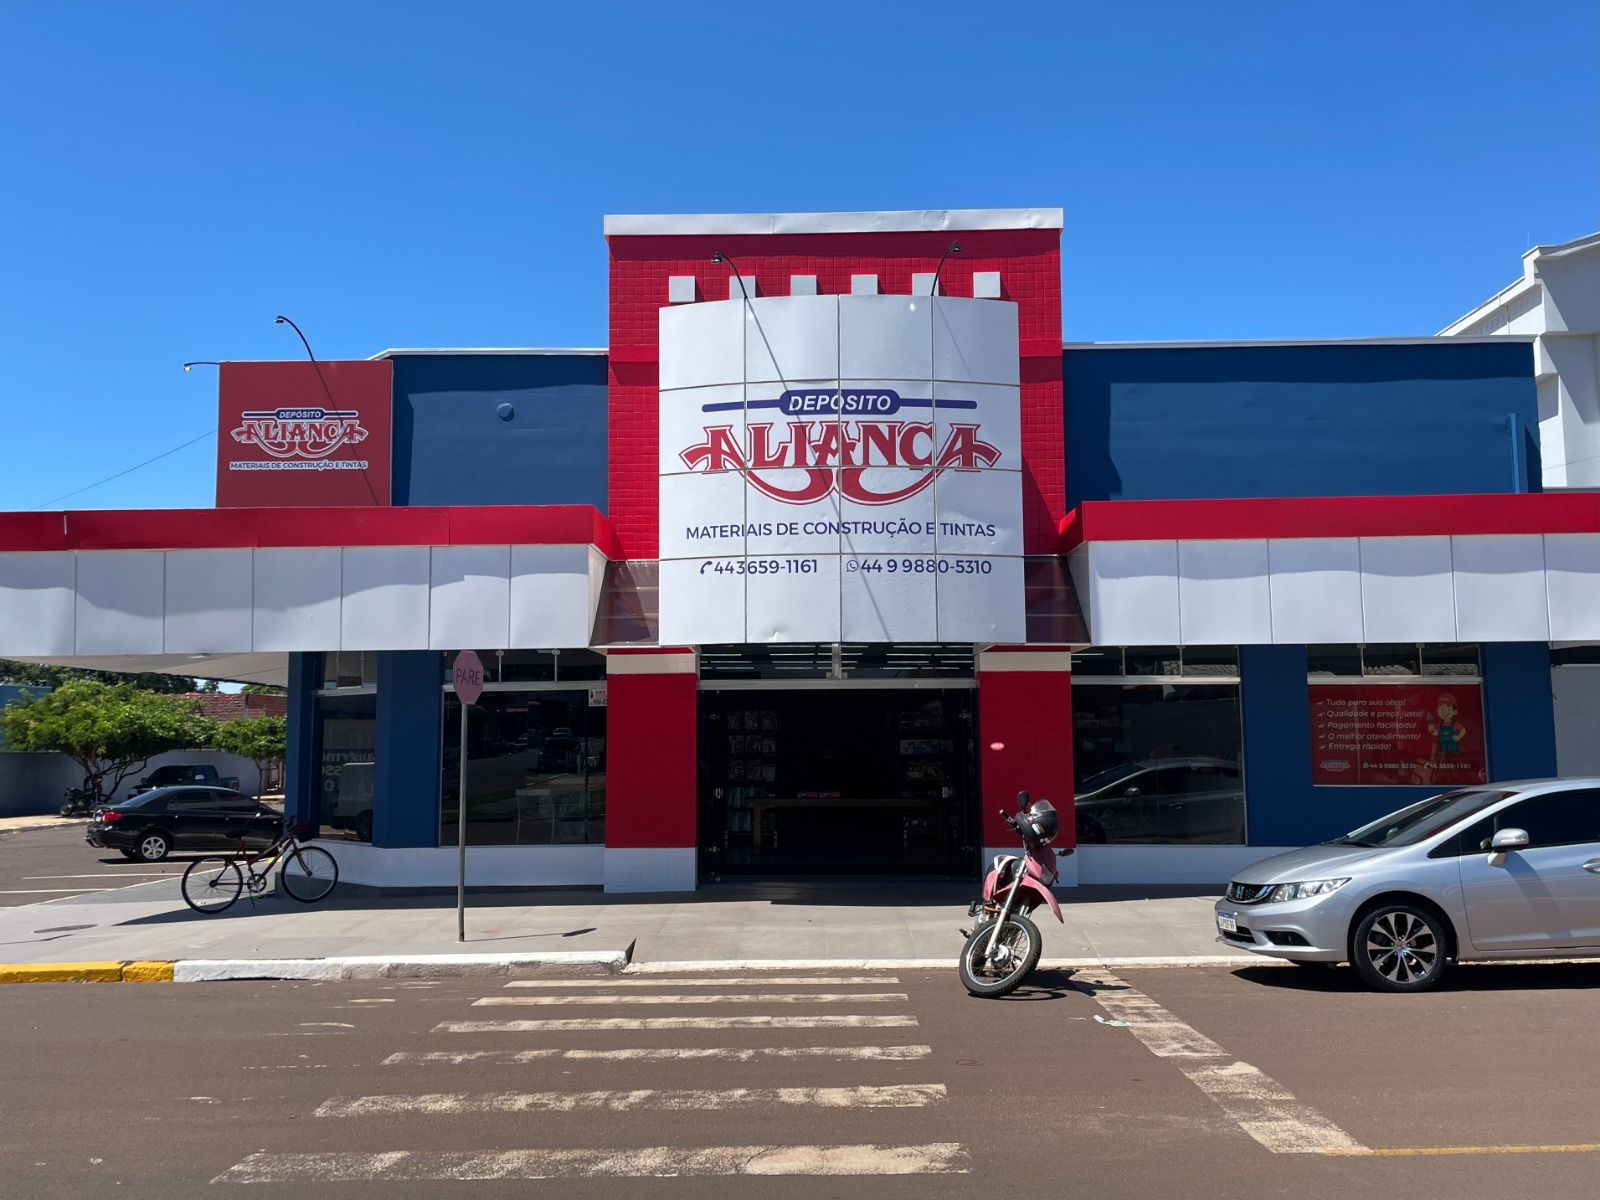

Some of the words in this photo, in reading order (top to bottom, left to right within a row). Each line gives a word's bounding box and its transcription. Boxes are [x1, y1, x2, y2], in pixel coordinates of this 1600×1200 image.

[788, 392, 892, 412] DEPÓSITO
[282, 460, 333, 470] CONSTRUÇÃO
[686, 523, 772, 540] MATERIAIS
[776, 522, 799, 536] DE
[803, 518, 922, 538] CONSTRUÇÃO
[926, 522, 935, 535] E
[940, 523, 996, 537] TINTAS
[861, 559, 883, 573] 44
[887, 559, 898, 573] 9
[902, 559, 992, 574] 9880-5310
[456, 668, 481, 686] PARE
[1347, 700, 1367, 708] para
[1327, 710, 1369, 718] Qualidade
[1377, 711, 1400, 719] preço
[1400, 710, 1424, 719] justo!
[1327, 722, 1376, 730] Pagamento
[1376, 721, 1417, 729] facilitado!
[1328, 743, 1360, 751] Entrega
[1362, 742, 1392, 751] rápida!
